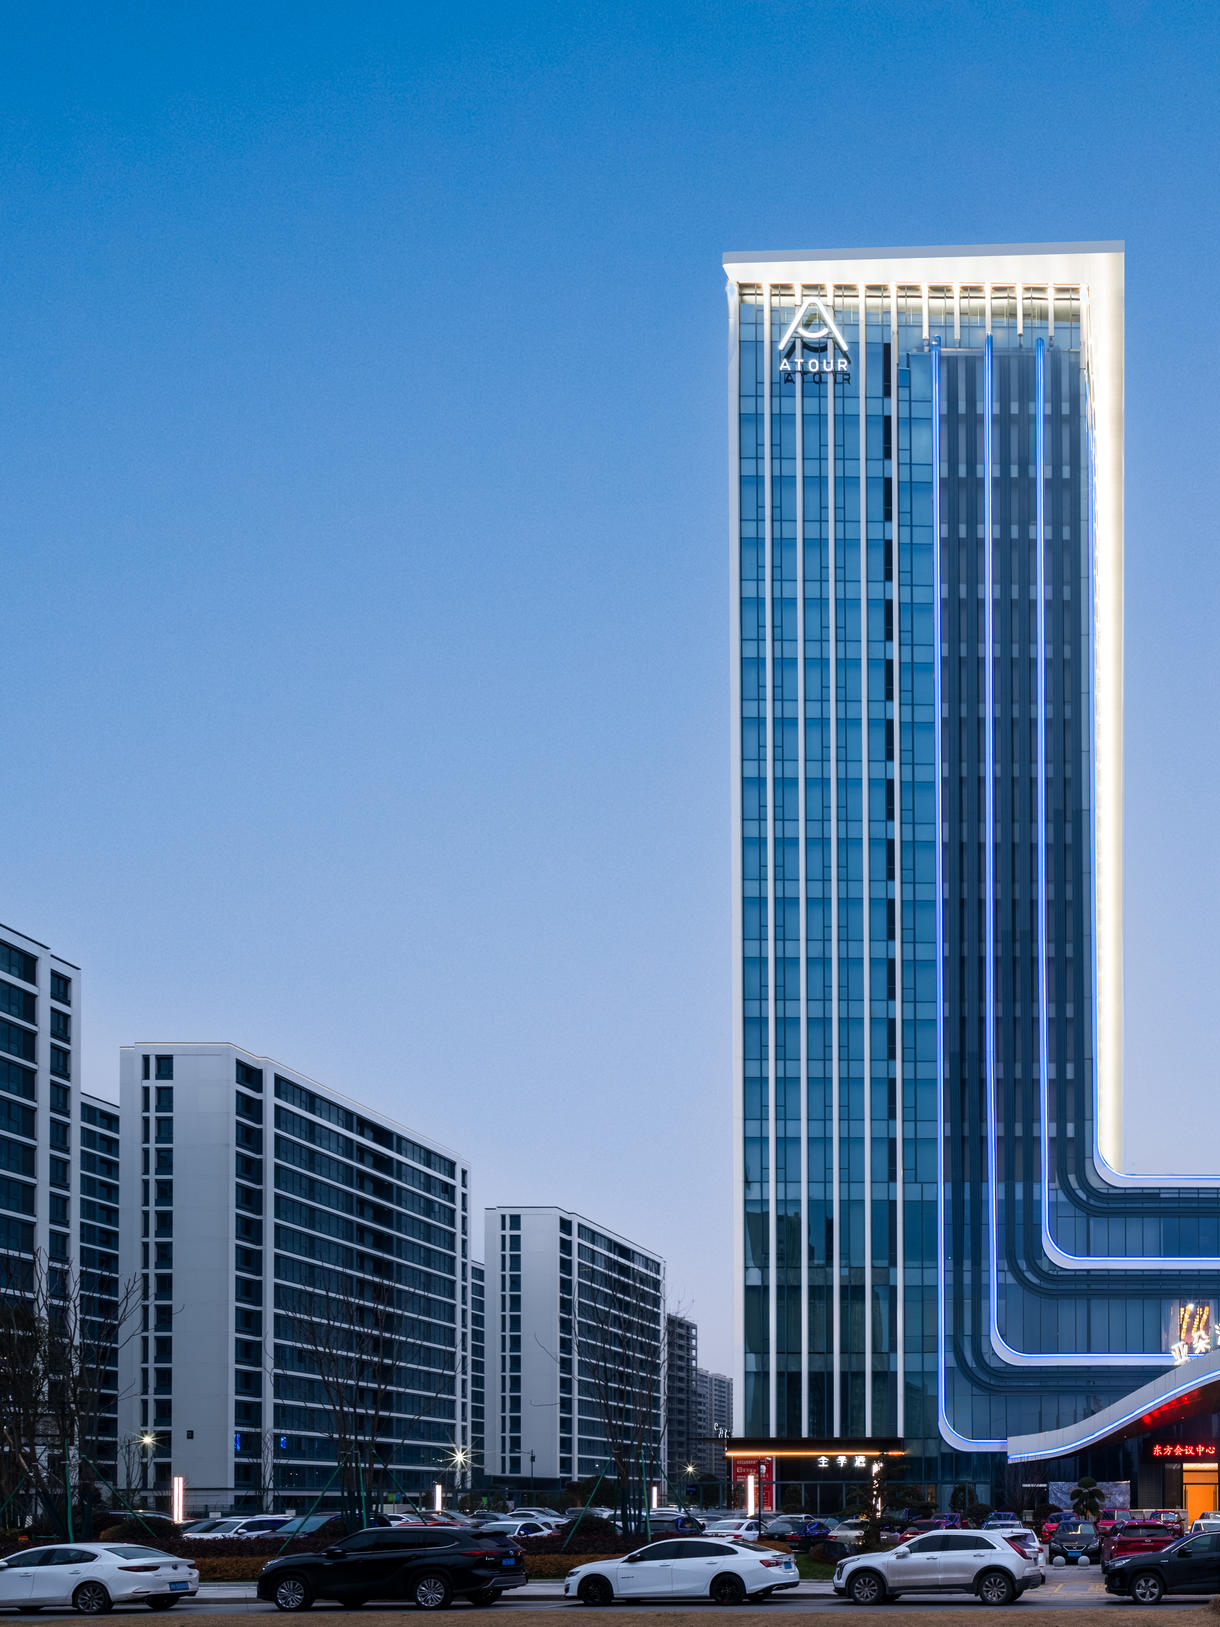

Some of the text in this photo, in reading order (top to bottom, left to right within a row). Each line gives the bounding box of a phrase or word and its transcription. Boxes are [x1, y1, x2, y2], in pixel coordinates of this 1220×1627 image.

[779, 359, 849, 372] ATOUR
[1153, 1444, 1217, 1457] 东方会议中心
